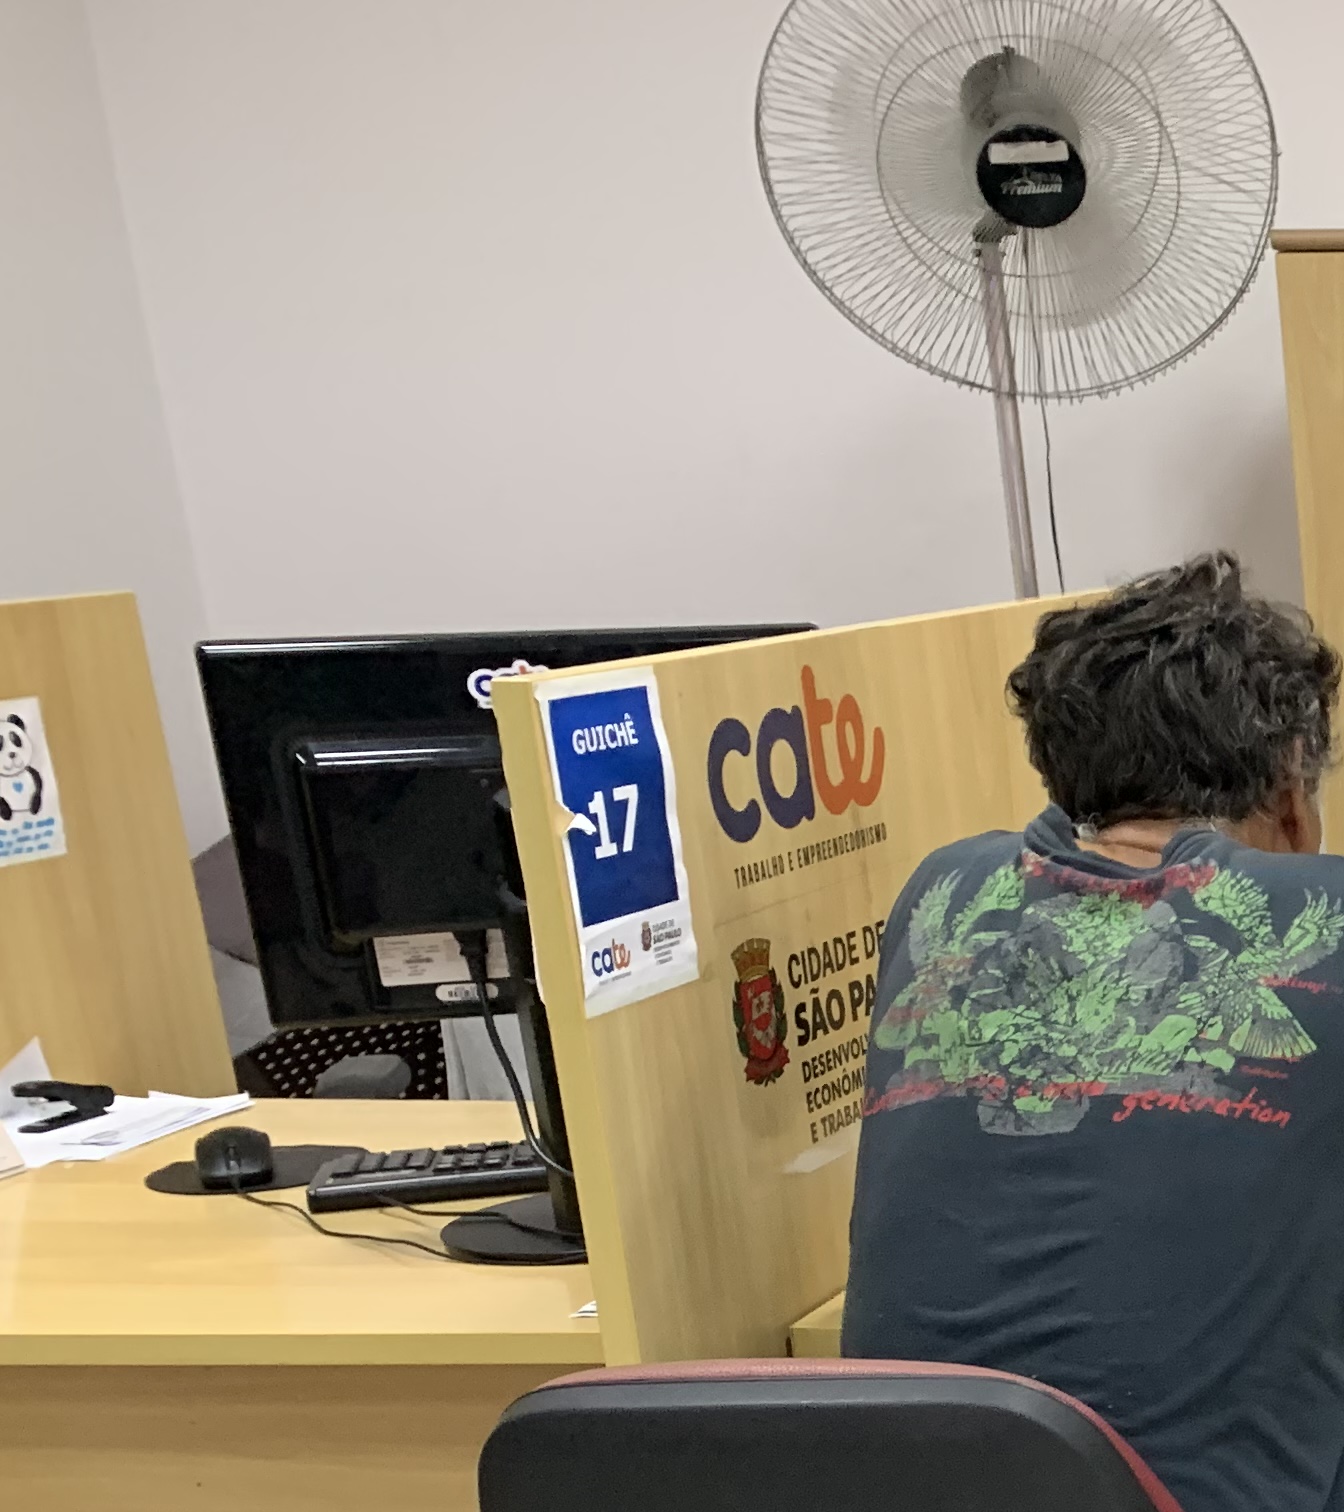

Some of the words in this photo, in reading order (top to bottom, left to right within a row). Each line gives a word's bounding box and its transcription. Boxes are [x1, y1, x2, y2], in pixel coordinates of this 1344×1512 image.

[572, 712, 639, 755] GUICHÊ
[708, 664, 885, 843] cate
[588, 784, 639, 860] 17
[734, 853, 785, 889] TRABALHO
[788, 851, 794, 872] E
[797, 822, 888, 869] EMPREENDEDORISMO
[591, 938, 631, 977] cate
[788, 930, 860, 990] CIDADE
[795, 987, 846, 1047] SÃO
[810, 1122, 819, 1144] E
